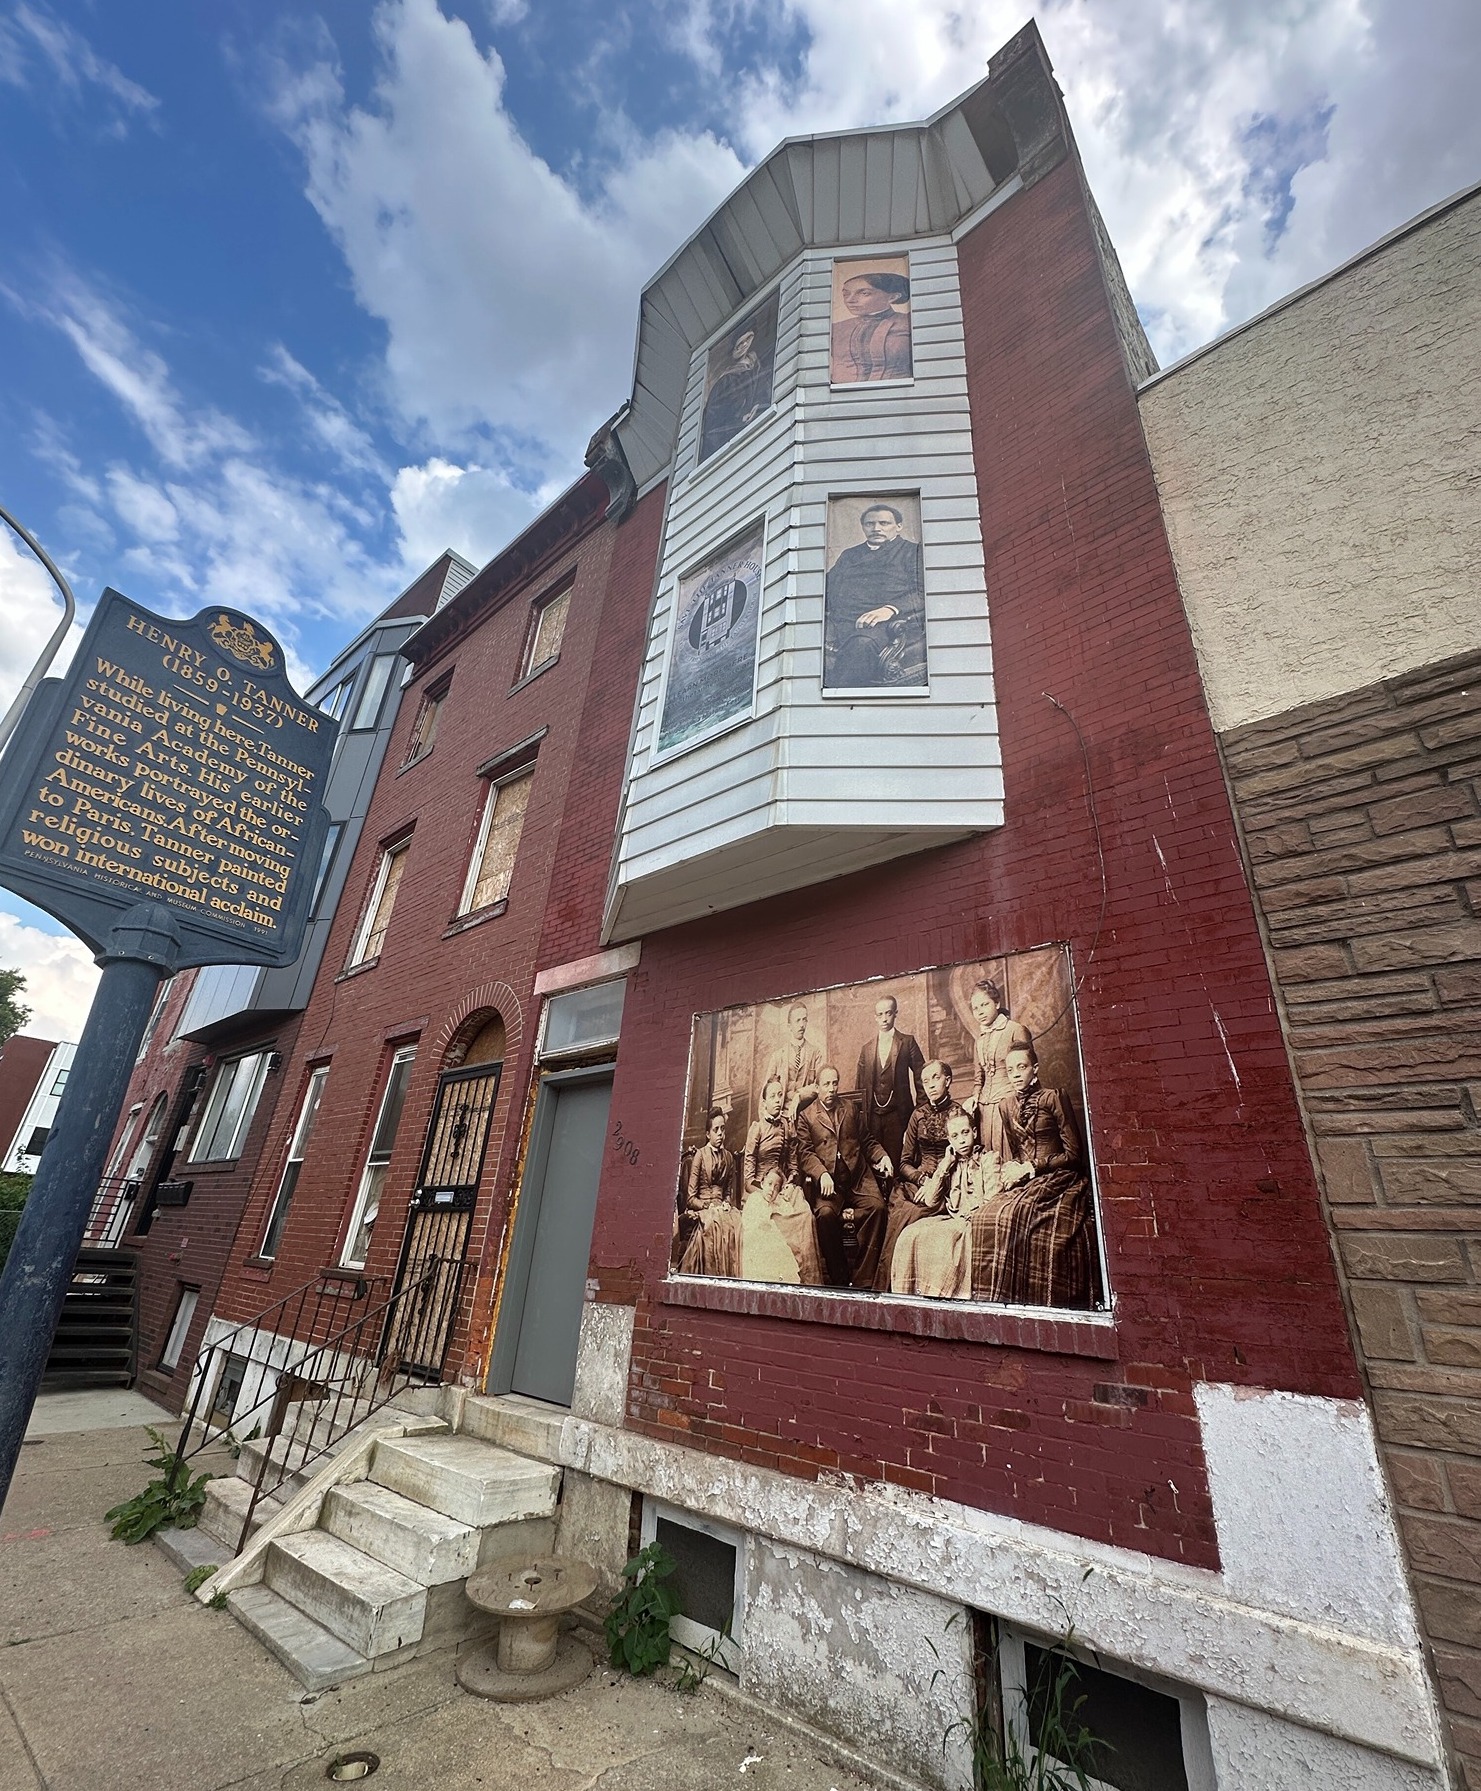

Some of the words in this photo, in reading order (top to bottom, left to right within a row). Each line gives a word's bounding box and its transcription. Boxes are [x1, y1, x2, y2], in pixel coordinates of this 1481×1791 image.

[97, 657, 154, 698] While
[157, 689, 212, 730] living
[258, 741, 315, 780] Tanner
[126, 614, 207, 668] HENRY
[216, 667, 232, 685] O.
[243, 680, 319, 733] TANNER
[162, 654, 283, 728] (1859-1937)
[65, 730, 130, 767] works
[133, 761, 237, 815] portrayed
[239, 807, 267, 828] the
[271, 824, 299, 841] or-
[70, 708, 127, 745] Fine
[134, 742, 192, 776] Arts.
[198, 767, 231, 793] His
[240, 791, 303, 827] earlier
[80, 694, 142, 734] vania
[151, 729, 248, 784] Academy
[254, 780, 277, 795] of
[280, 789, 307, 811] the
[86, 679, 170, 726] studied
[174, 722, 194, 738] at
[199, 731, 229, 755] the
[235, 747, 312, 793] Pennsyl-
[39, 786, 64, 807] to
[71, 797, 135, 836] Paris,
[140, 822, 215, 864] Tanner
[218, 858, 288, 894] painted
[44, 767, 167, 828] Americans.
[167, 816, 228, 849] After
[228, 842, 291, 879] moving
[55, 748, 136, 793] dinary
[139, 781, 187, 813] lives
[192, 809, 218, 825] of
[215, 817, 295, 858] African-
[22, 829, 70, 857] won
[75, 843, 208, 904] international
[210, 896, 277, 929] acclaim.
[24, 849, 88, 876] PENNSYLVANIA
[145, 890, 163, 899] AND
[166, 897, 197, 911] MUSEUM
[200, 909, 245, 928] COMMISSION
[28, 809, 142, 859] religious
[152, 855, 239, 894] subjects
[246, 889, 283, 911] and
[612, 1121, 640, 1166] 2908
